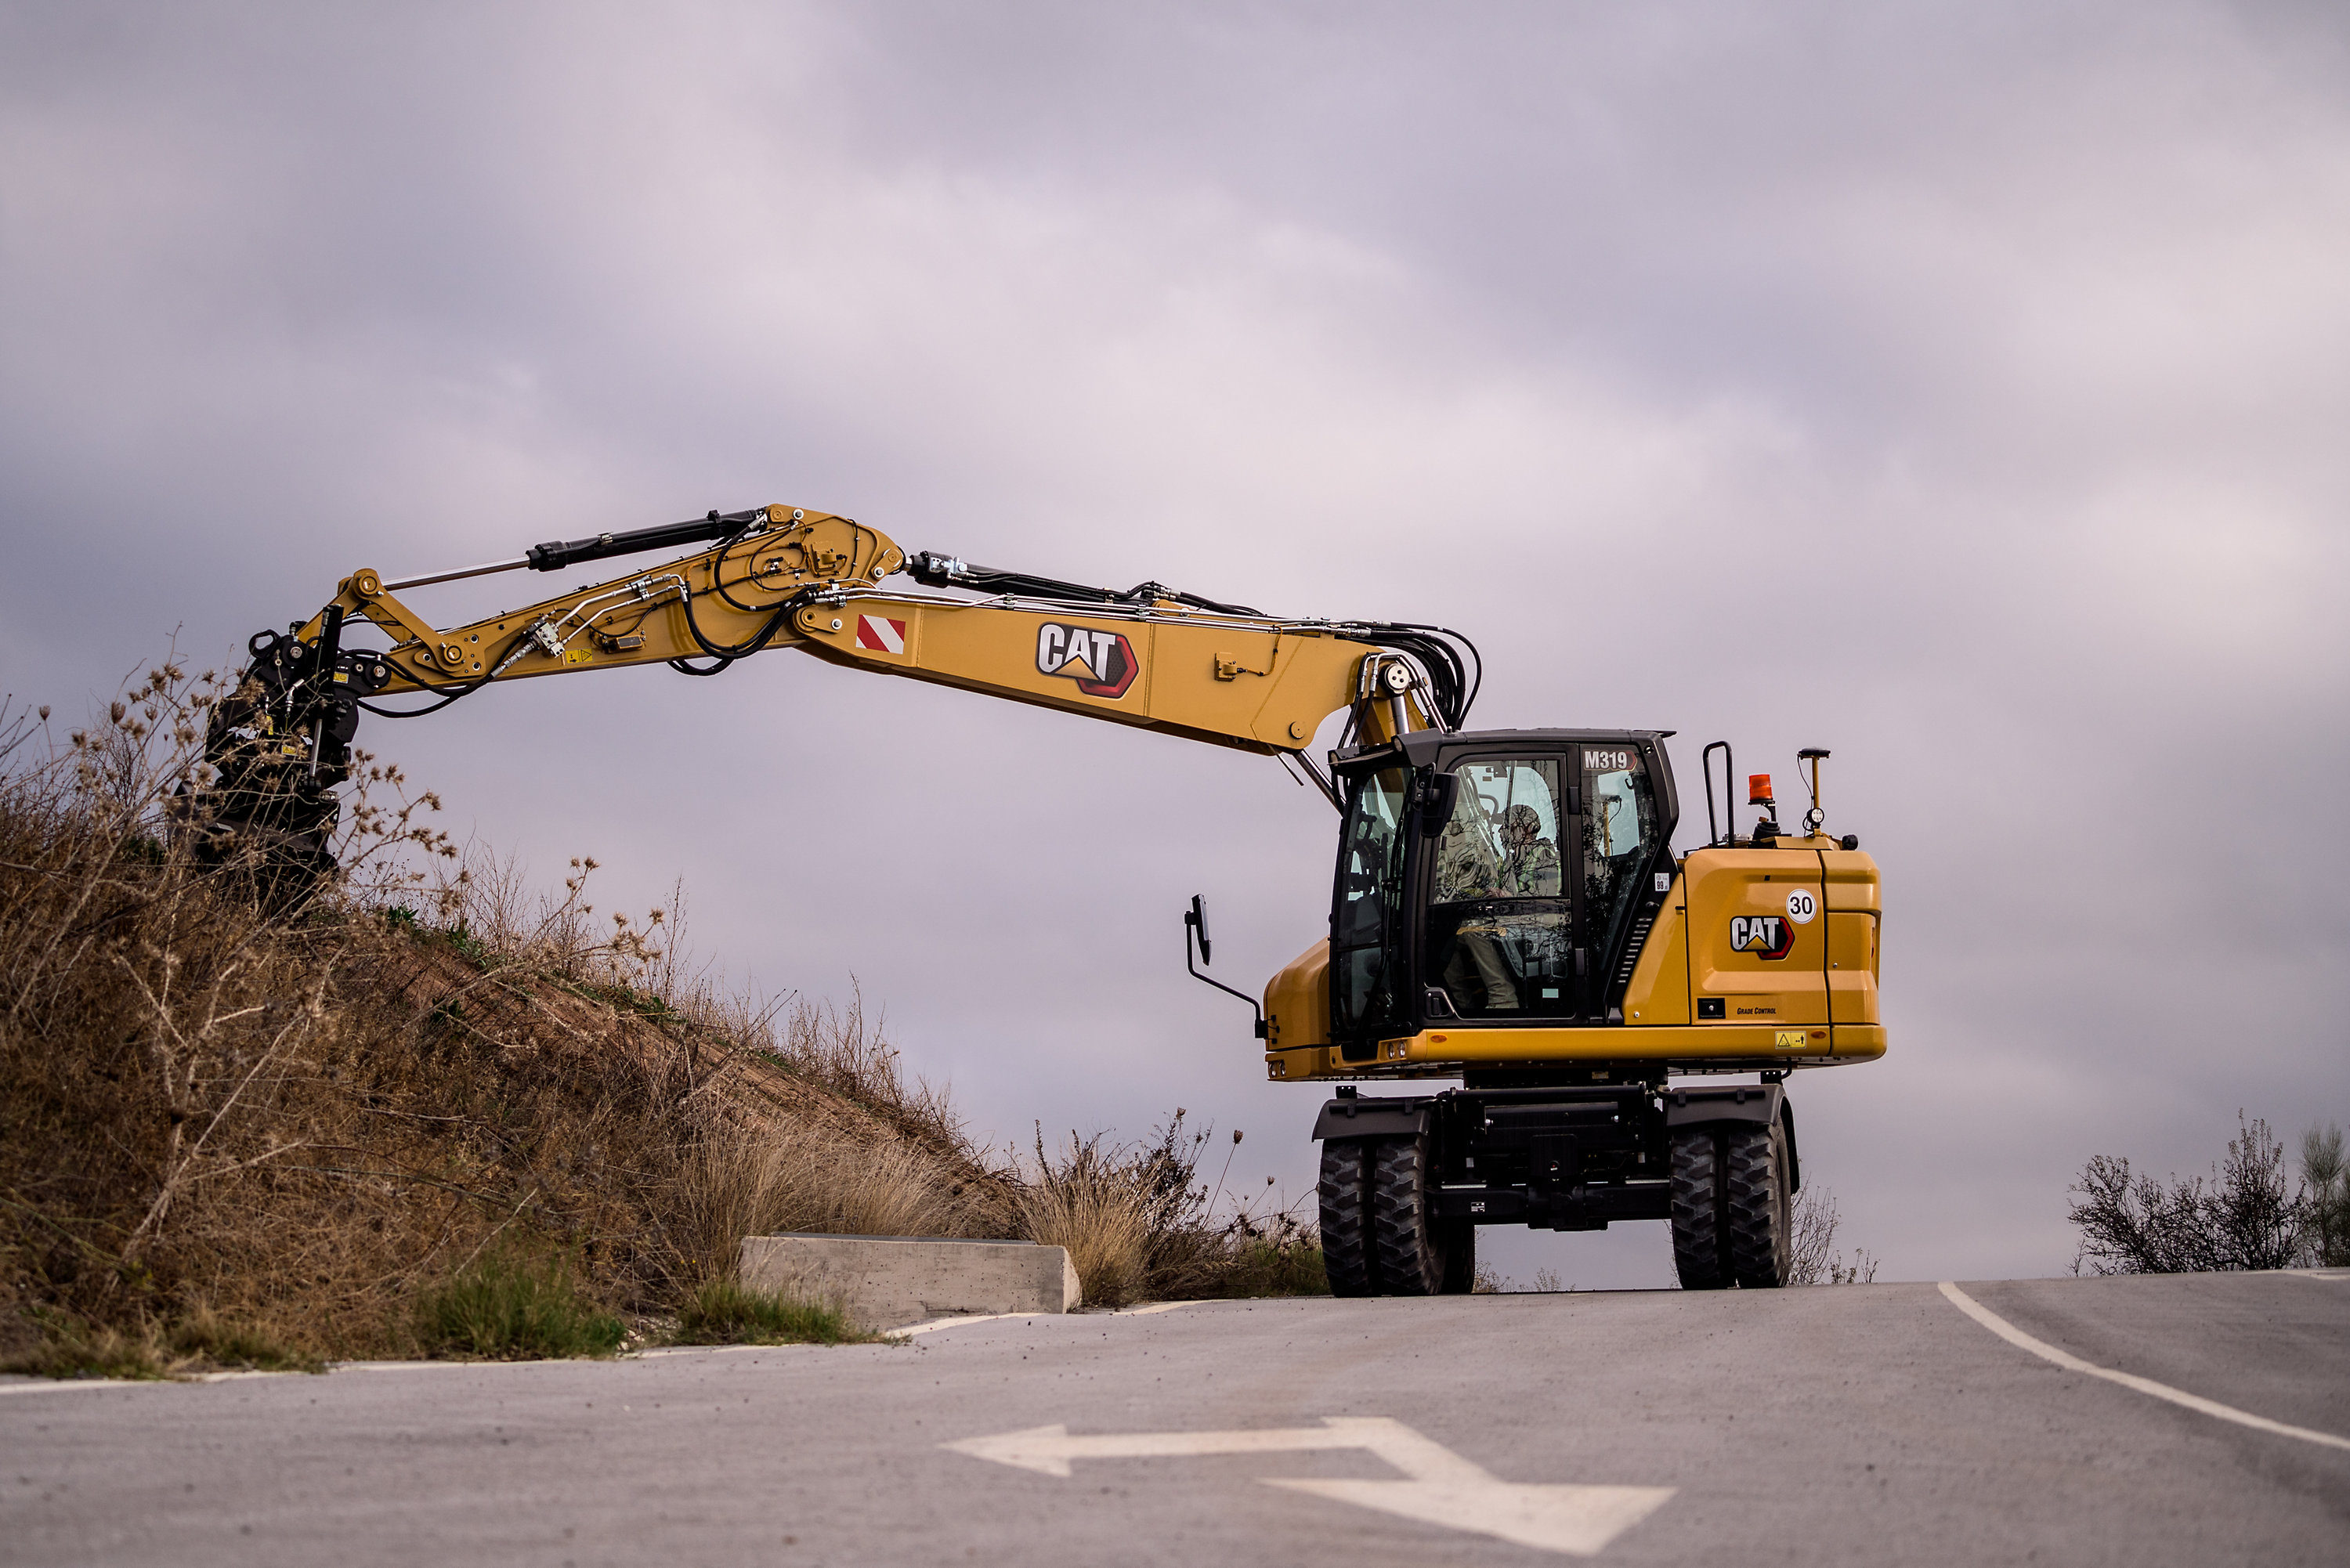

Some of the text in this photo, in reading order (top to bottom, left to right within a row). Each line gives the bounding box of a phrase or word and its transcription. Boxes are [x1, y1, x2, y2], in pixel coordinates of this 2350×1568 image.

[1038, 623, 1116, 681] CAT
[1585, 750, 1628, 769] M319
[1790, 896, 1813, 915] 30
[1731, 917, 1780, 950] CAT
